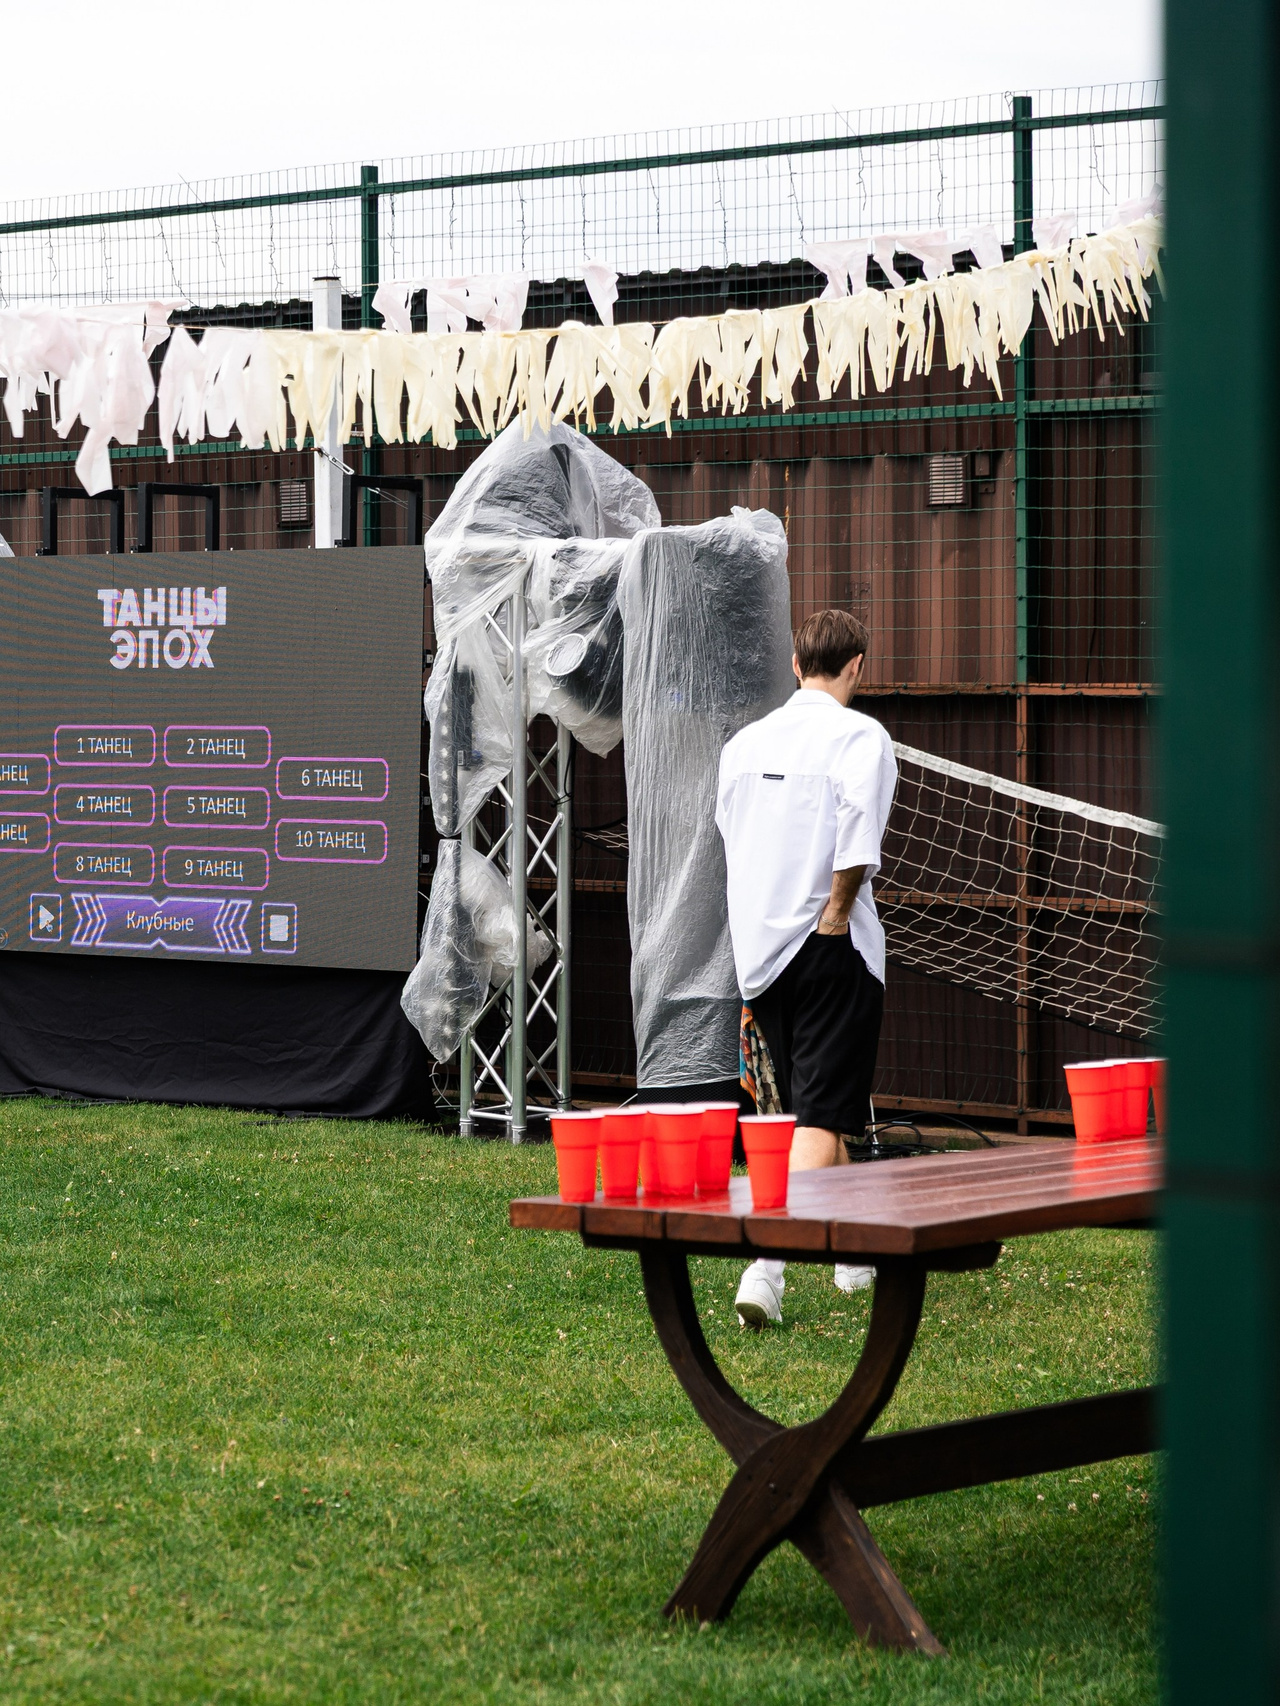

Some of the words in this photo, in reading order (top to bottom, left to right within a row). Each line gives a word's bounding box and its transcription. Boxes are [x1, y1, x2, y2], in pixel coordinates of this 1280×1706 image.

[97, 586, 227, 633] ТАНЦЫ
[109, 628, 215, 670] ЭПОХ
[77, 737, 84, 754] 1
[87, 737, 133, 758] ТАНЕЦ
[186, 737, 195, 755] 2
[198, 738, 246, 760] ТАНЕЦ
[301, 768, 311, 787] 6
[314, 769, 363, 790] ТАНЕЦ
[76, 795, 85, 813] 4
[87, 795, 132, 816] ТАНЕЦ
[187, 796, 196, 814] 5
[199, 796, 247, 817] ТАНЕЦ
[295, 830, 313, 848] 10
[317, 830, 366, 851] ТАНЕЦ
[75, 855, 84, 872] 8
[86, 855, 132, 876] ТАНЕЦ
[184, 859, 194, 876] 9
[197, 859, 244, 880] ТАНЕЦ
[126, 910, 194, 932] Клубные
